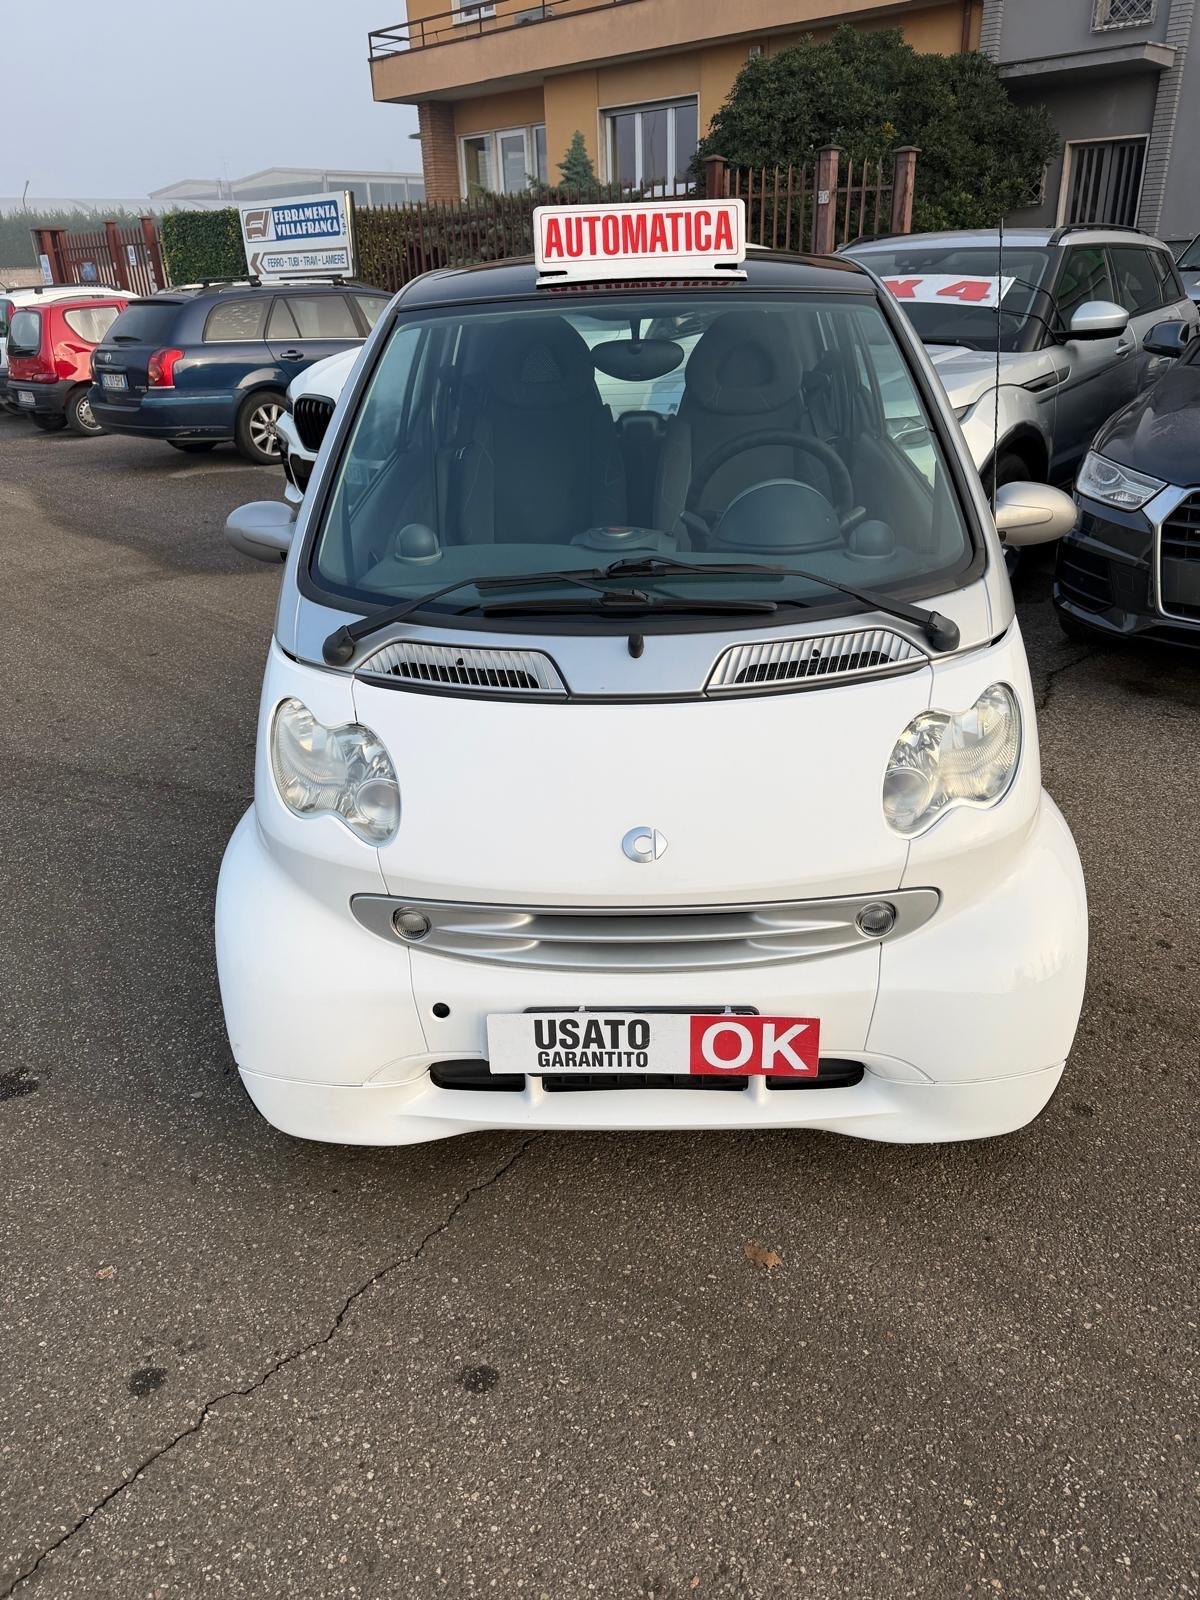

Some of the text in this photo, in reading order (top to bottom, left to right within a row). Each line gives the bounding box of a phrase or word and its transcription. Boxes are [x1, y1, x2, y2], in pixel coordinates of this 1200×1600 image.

[273, 204, 337, 223] FERRAMENTA
[275, 219, 340, 236] VILLAFRANCA
[545, 210, 733, 257] AUTOMATICA
[267, 257, 284, 268] FERRO
[288, 256, 300, 267] TUBI
[321, 253, 345, 265] LAMIERE
[936, 280, 992, 302] 4
[533, 1018, 651, 1050] USATO
[701, 1021, 810, 1071] OK
[537, 1050, 649, 1068] GARANTITO
